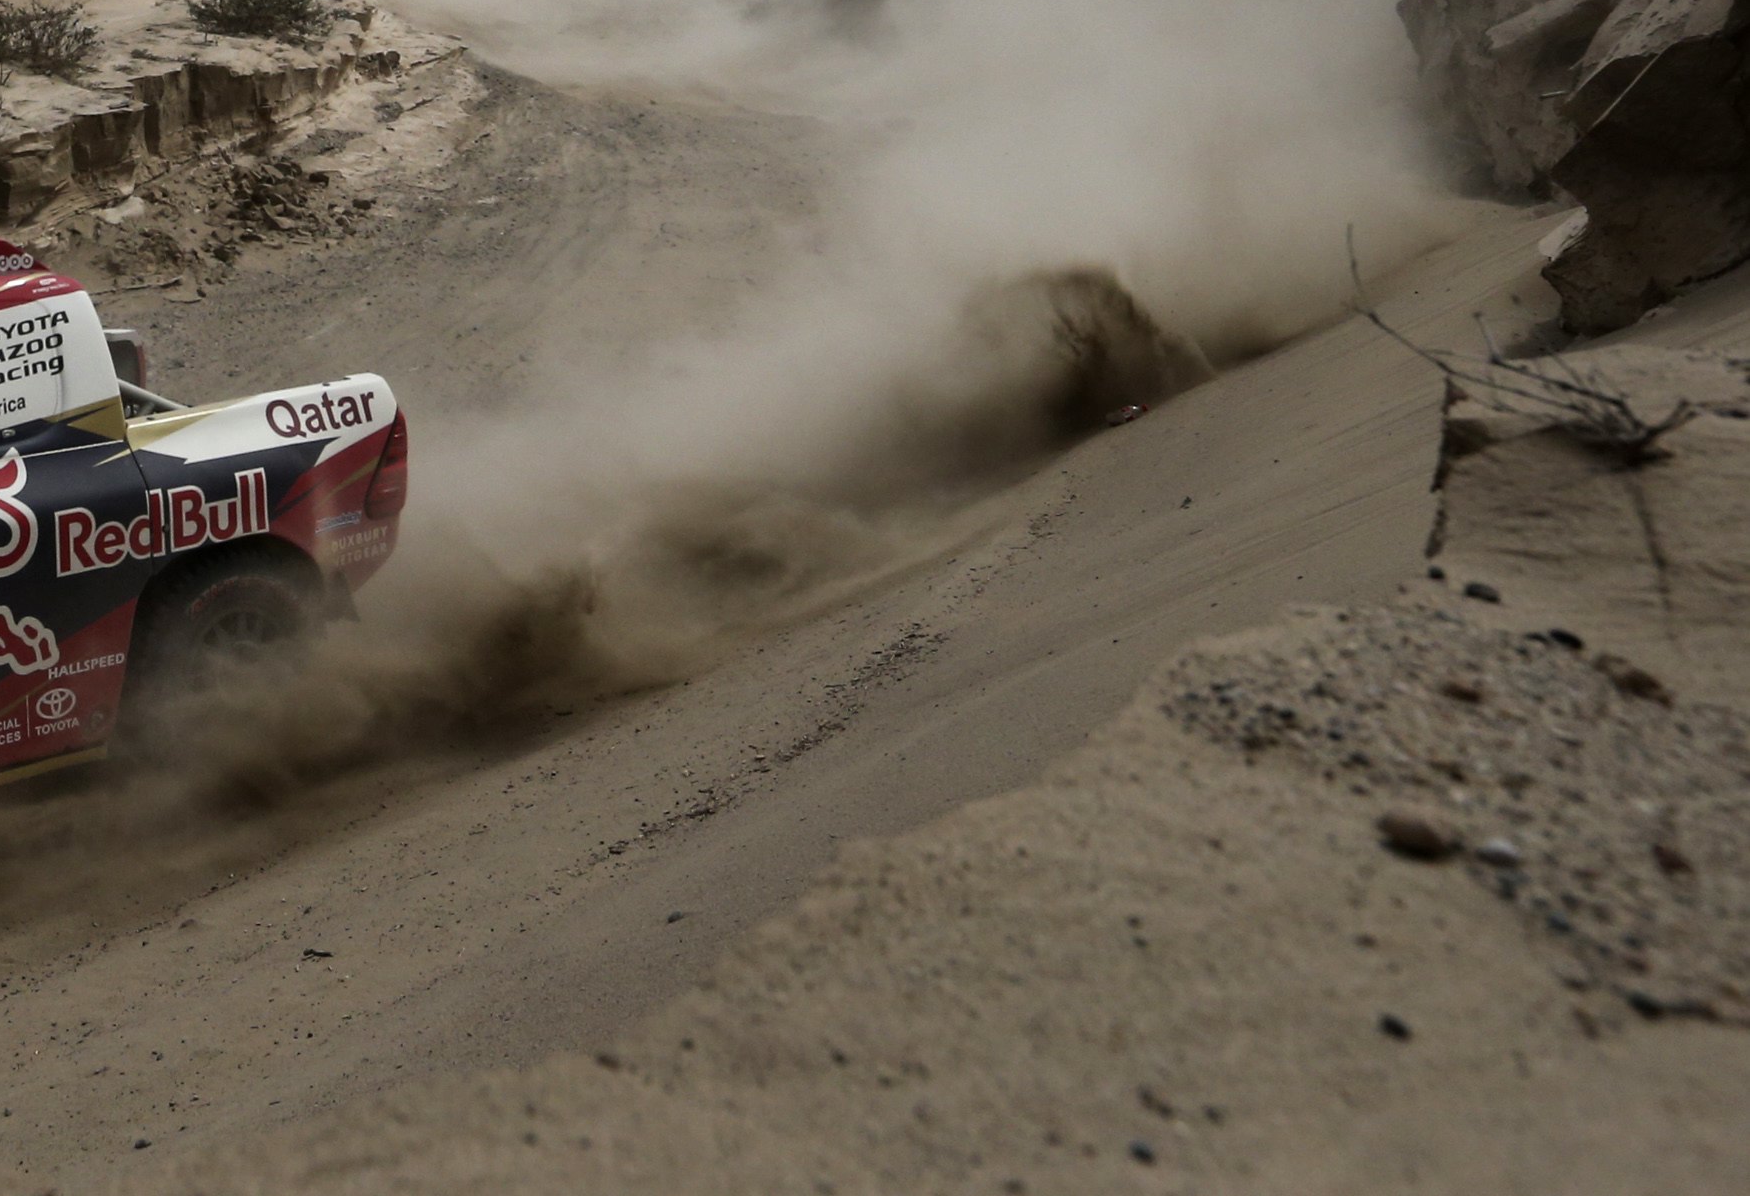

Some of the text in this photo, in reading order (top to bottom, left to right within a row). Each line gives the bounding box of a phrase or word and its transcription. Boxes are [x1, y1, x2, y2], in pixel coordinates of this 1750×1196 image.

[265, 391, 374, 439] Qatar
[48, 653, 125, 680] HALLSPEED
[34, 716, 80, 736] TOYOTA
